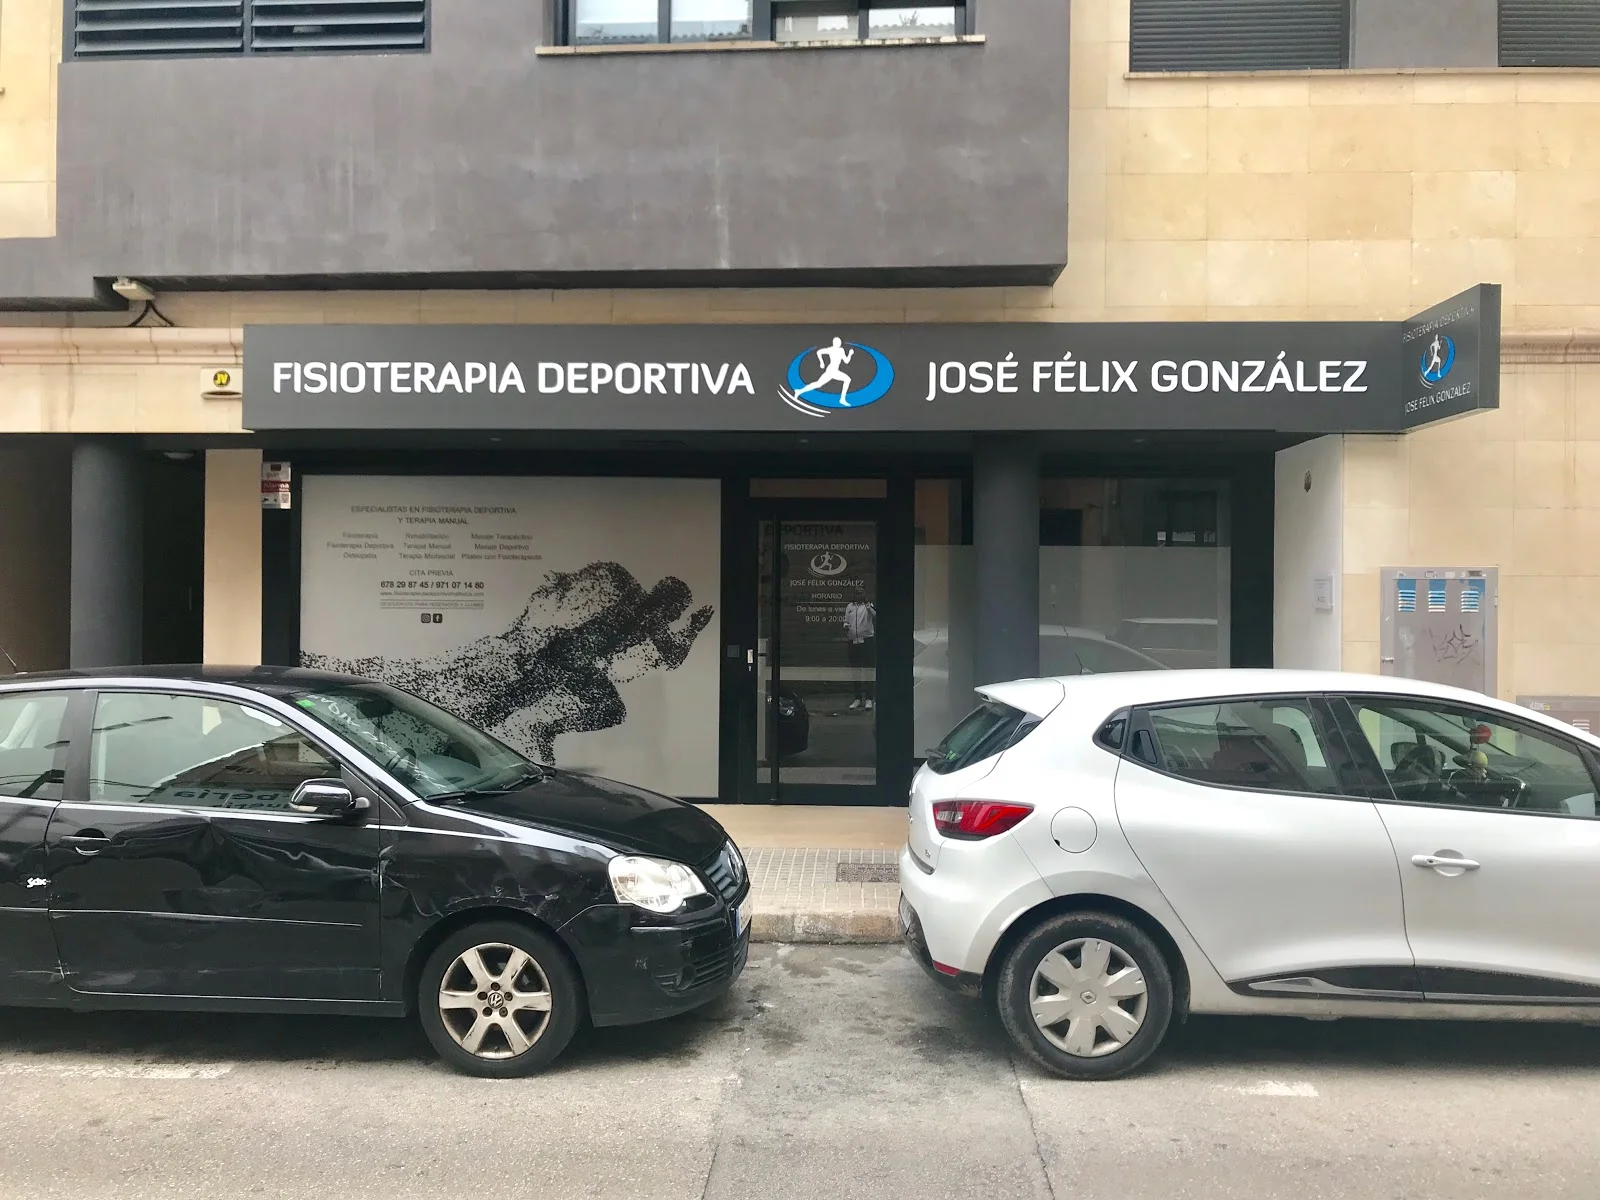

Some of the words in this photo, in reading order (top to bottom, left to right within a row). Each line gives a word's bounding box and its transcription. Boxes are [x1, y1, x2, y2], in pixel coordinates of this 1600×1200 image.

[272, 361, 526, 394] FISIOTERAPIA
[537, 361, 756, 395] DEPORTIVA
[925, 351, 1019, 401] JOSÉ
[1032, 350, 1138, 393] FÉLIX
[1150, 350, 1368, 393] GONZÁLEZ
[351, 505, 407, 513] ESPECIALISTAS
[409, 505, 420, 513] EN
[474, 506, 516, 514] DEPORTIVA
[409, 569, 426, 577] CITA
[435, 581, 449, 589] 971
[789, 578, 806, 587] JOSÉ
[807, 578, 826, 587] FÉLIX
[827, 578, 864, 587] GONZÁLEZ
